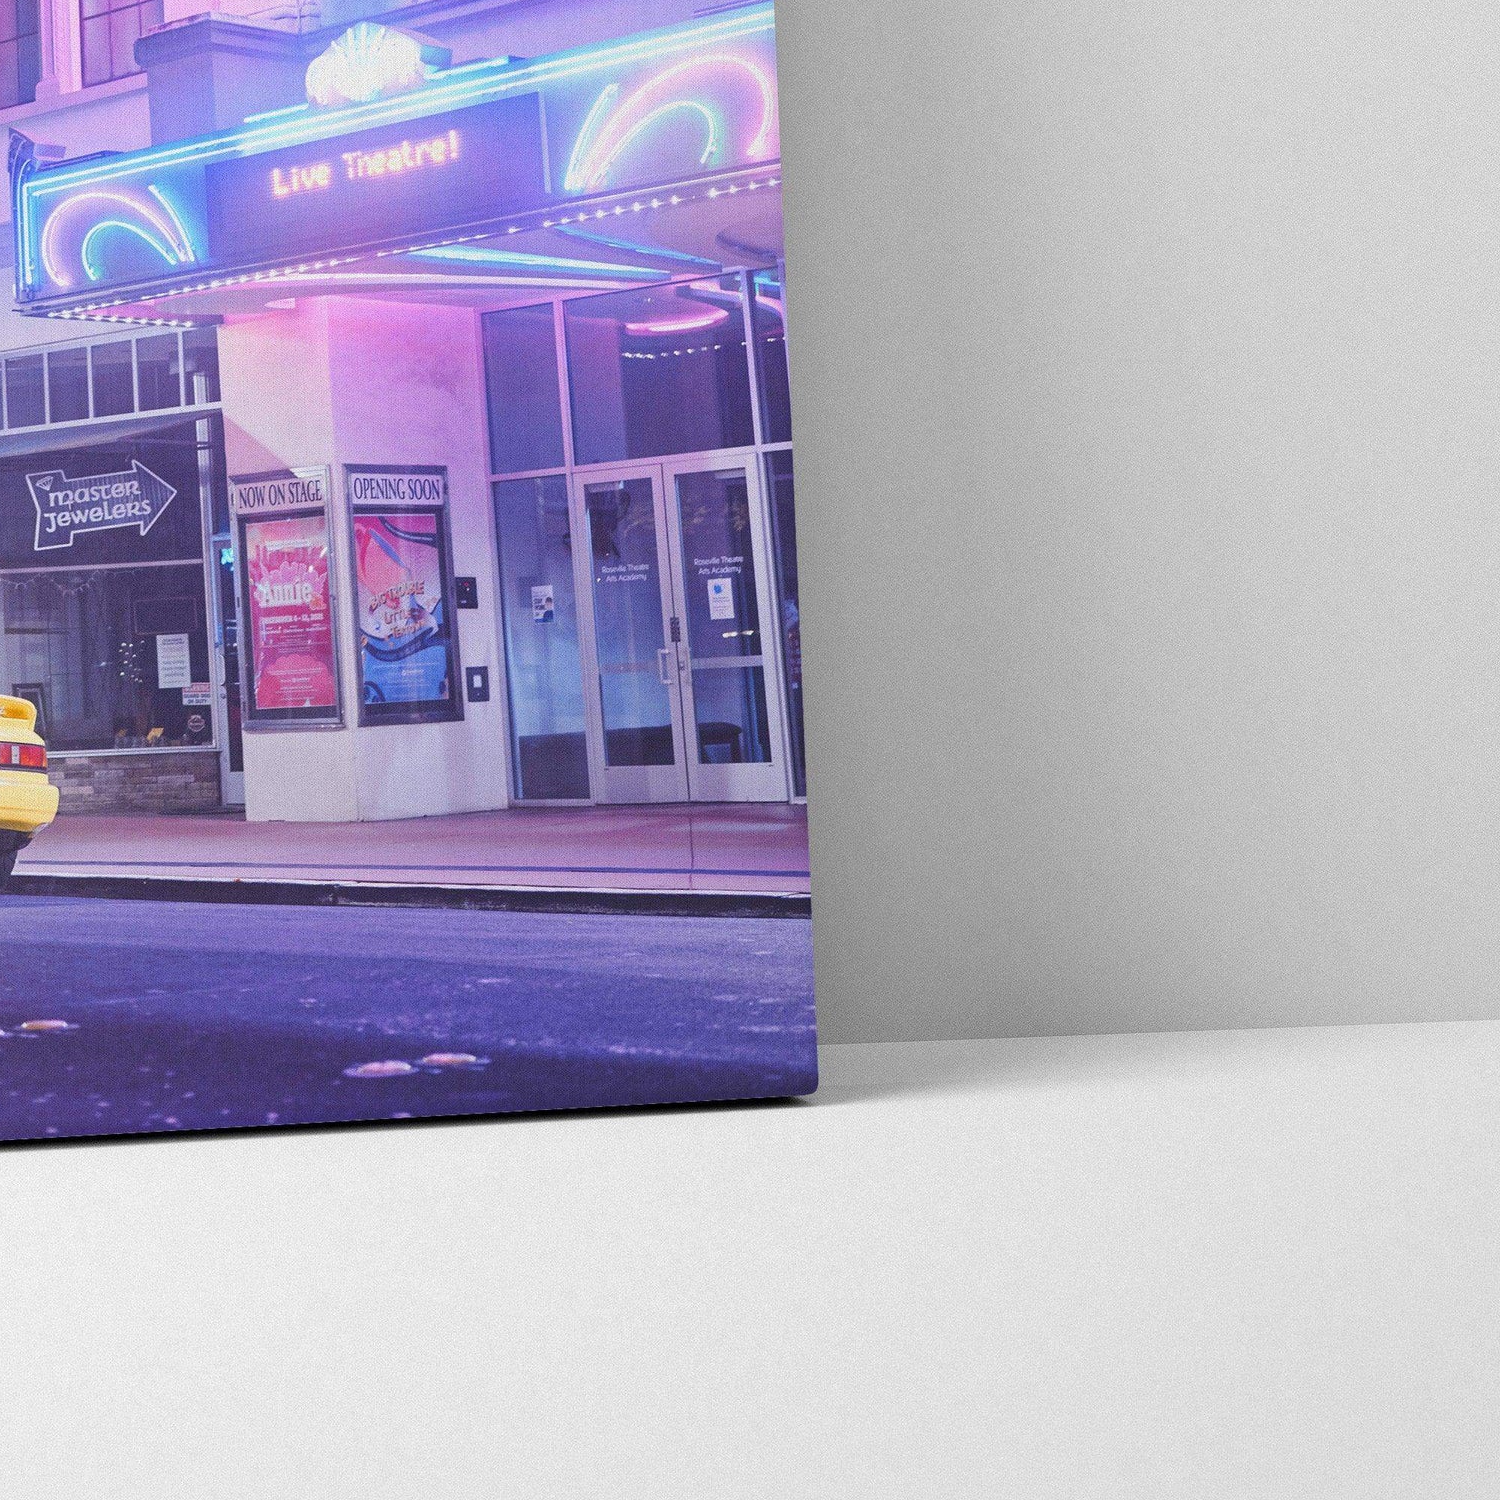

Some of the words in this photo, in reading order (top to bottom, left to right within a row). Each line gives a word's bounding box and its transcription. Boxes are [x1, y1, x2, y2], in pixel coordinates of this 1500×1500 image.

[271, 167, 331, 197] Live
[342, 129, 461, 179] Theatre!
[239, 485, 266, 509] NOW
[268, 483, 286, 506] ON
[288, 479, 323, 504] STAGE
[354, 477, 406, 500] OPENING
[408, 478, 442, 501] SOON
[602, 565, 626, 574] Roseville
[628, 563, 650, 571] Theatre
[694, 557, 720, 565] Roseville
[720, 555, 744, 563] Theatre
[618, 574, 647, 582] Academy
[711, 566, 742, 574] Academy
[260, 579, 312, 607] Annie
